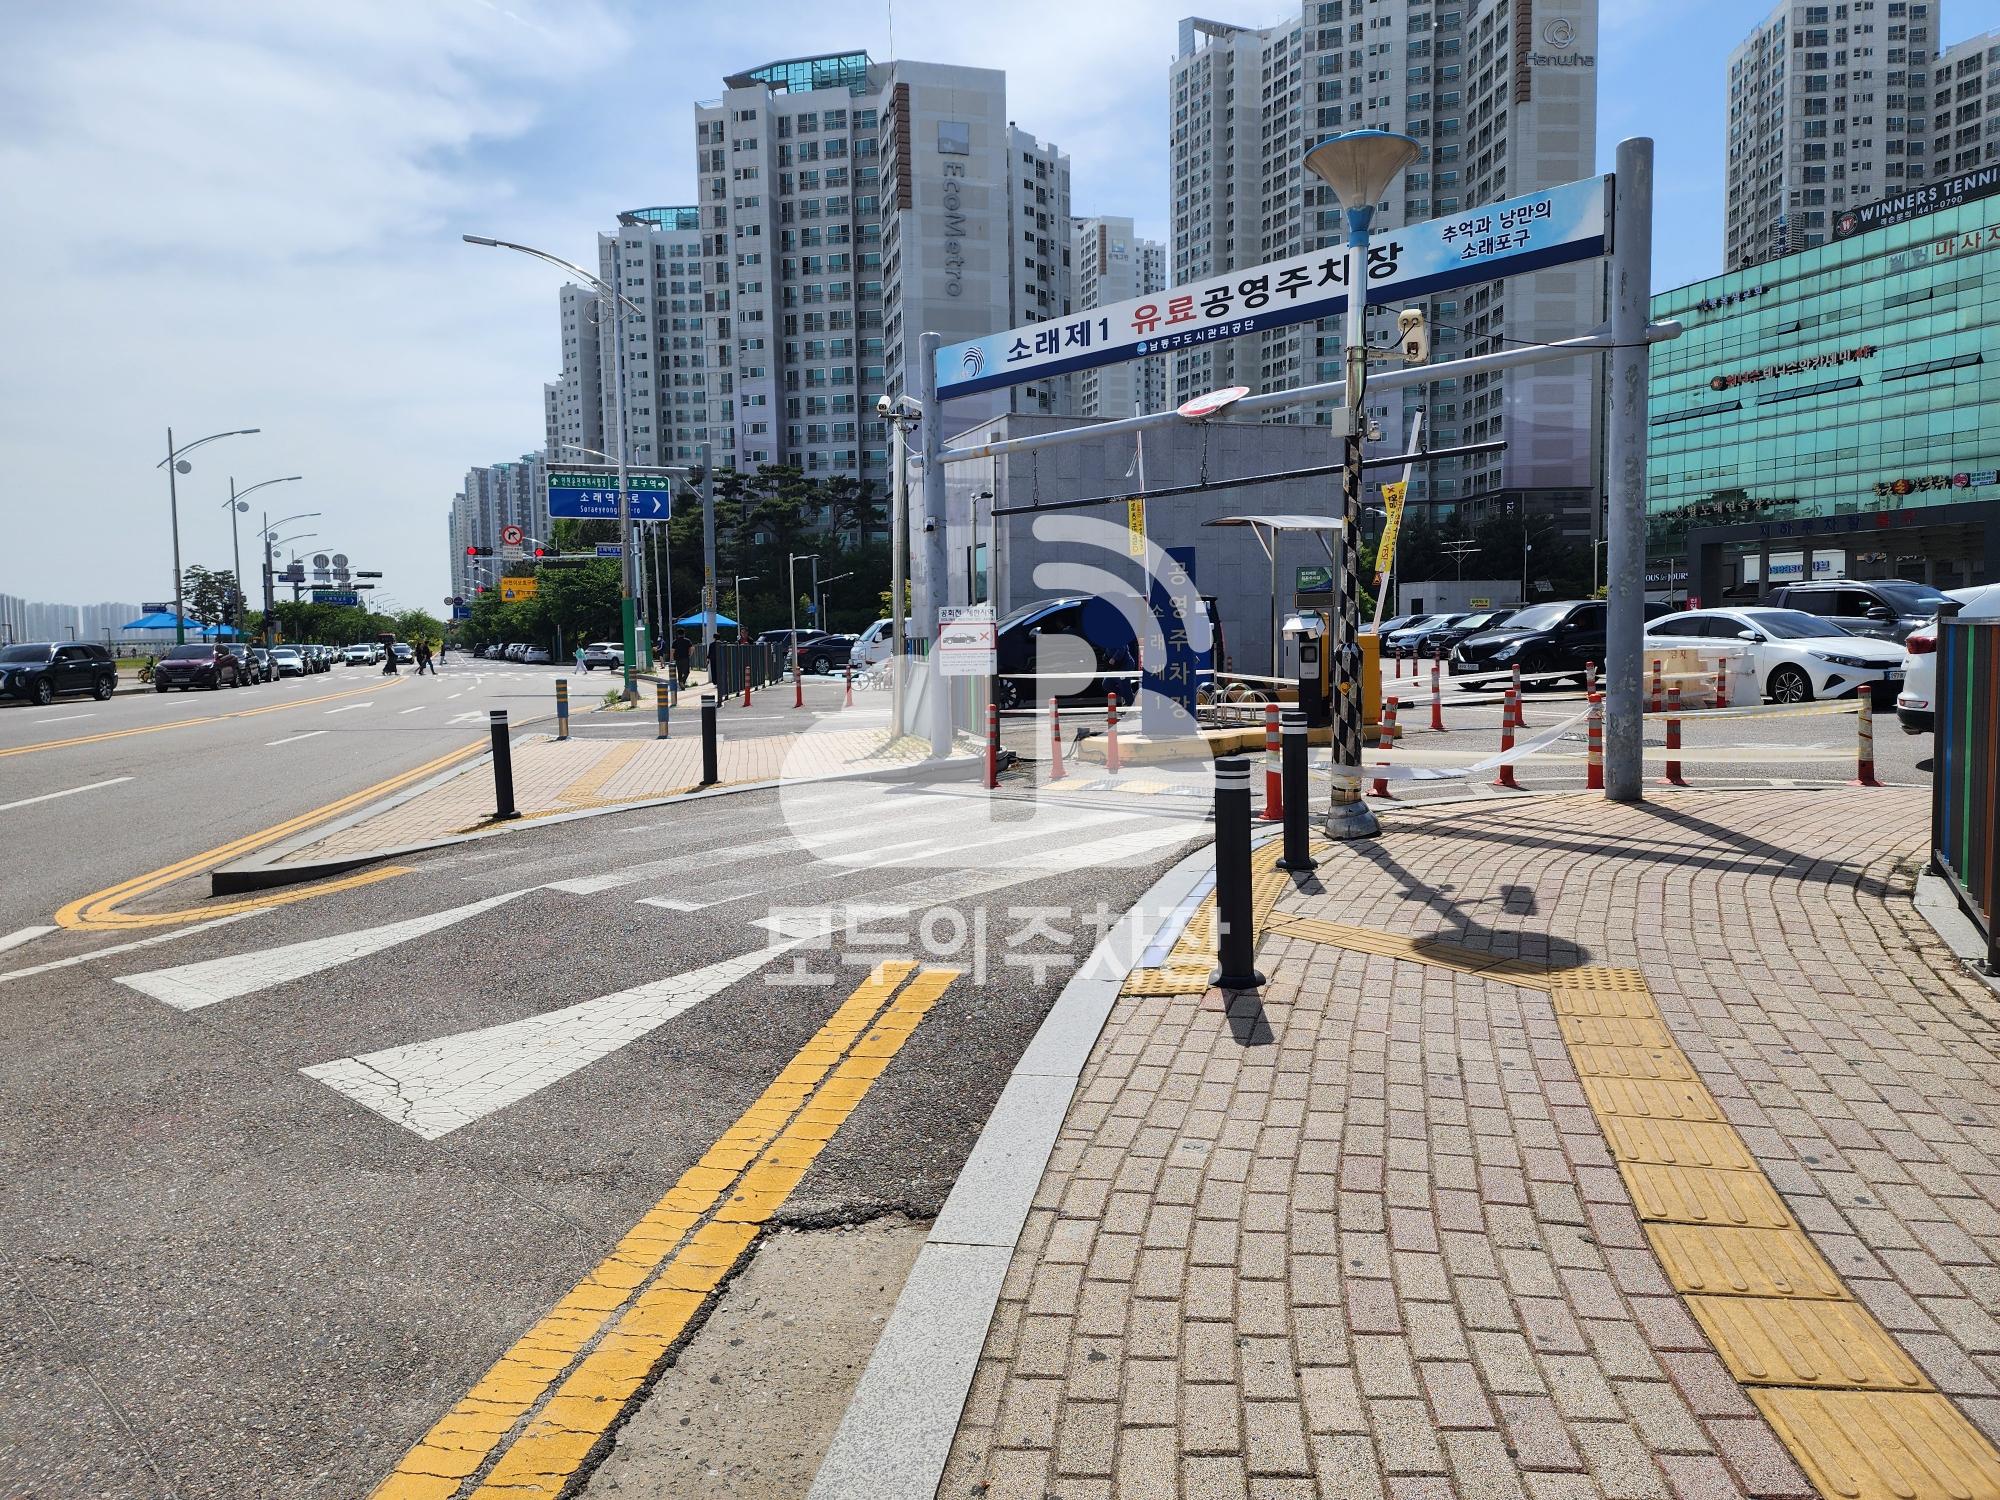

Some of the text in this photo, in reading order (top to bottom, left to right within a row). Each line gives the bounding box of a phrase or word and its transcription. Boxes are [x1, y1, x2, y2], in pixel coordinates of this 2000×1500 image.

[1525, 52, 1595, 67] Hanwha
[1860, 167, 2000, 222] WINNERS TENNI
[1917, 194, 1963, 215] 441-0790
[942, 161, 966, 298] EcoMetro
[1442, 199, 1552, 243] 추억과 낭만의
[1460, 229, 1531, 260] 소래포구
[1006, 316, 1109, 364] 소래제1
[1149, 318, 1255, 352] 남동구도시관리공단
[580, 492, 640, 505] 소래역로
[613, 479, 657, 489] 소포구역
[1645, 573, 1660, 582] OUS
[1167, 562, 1191, 719] 공영주차장
